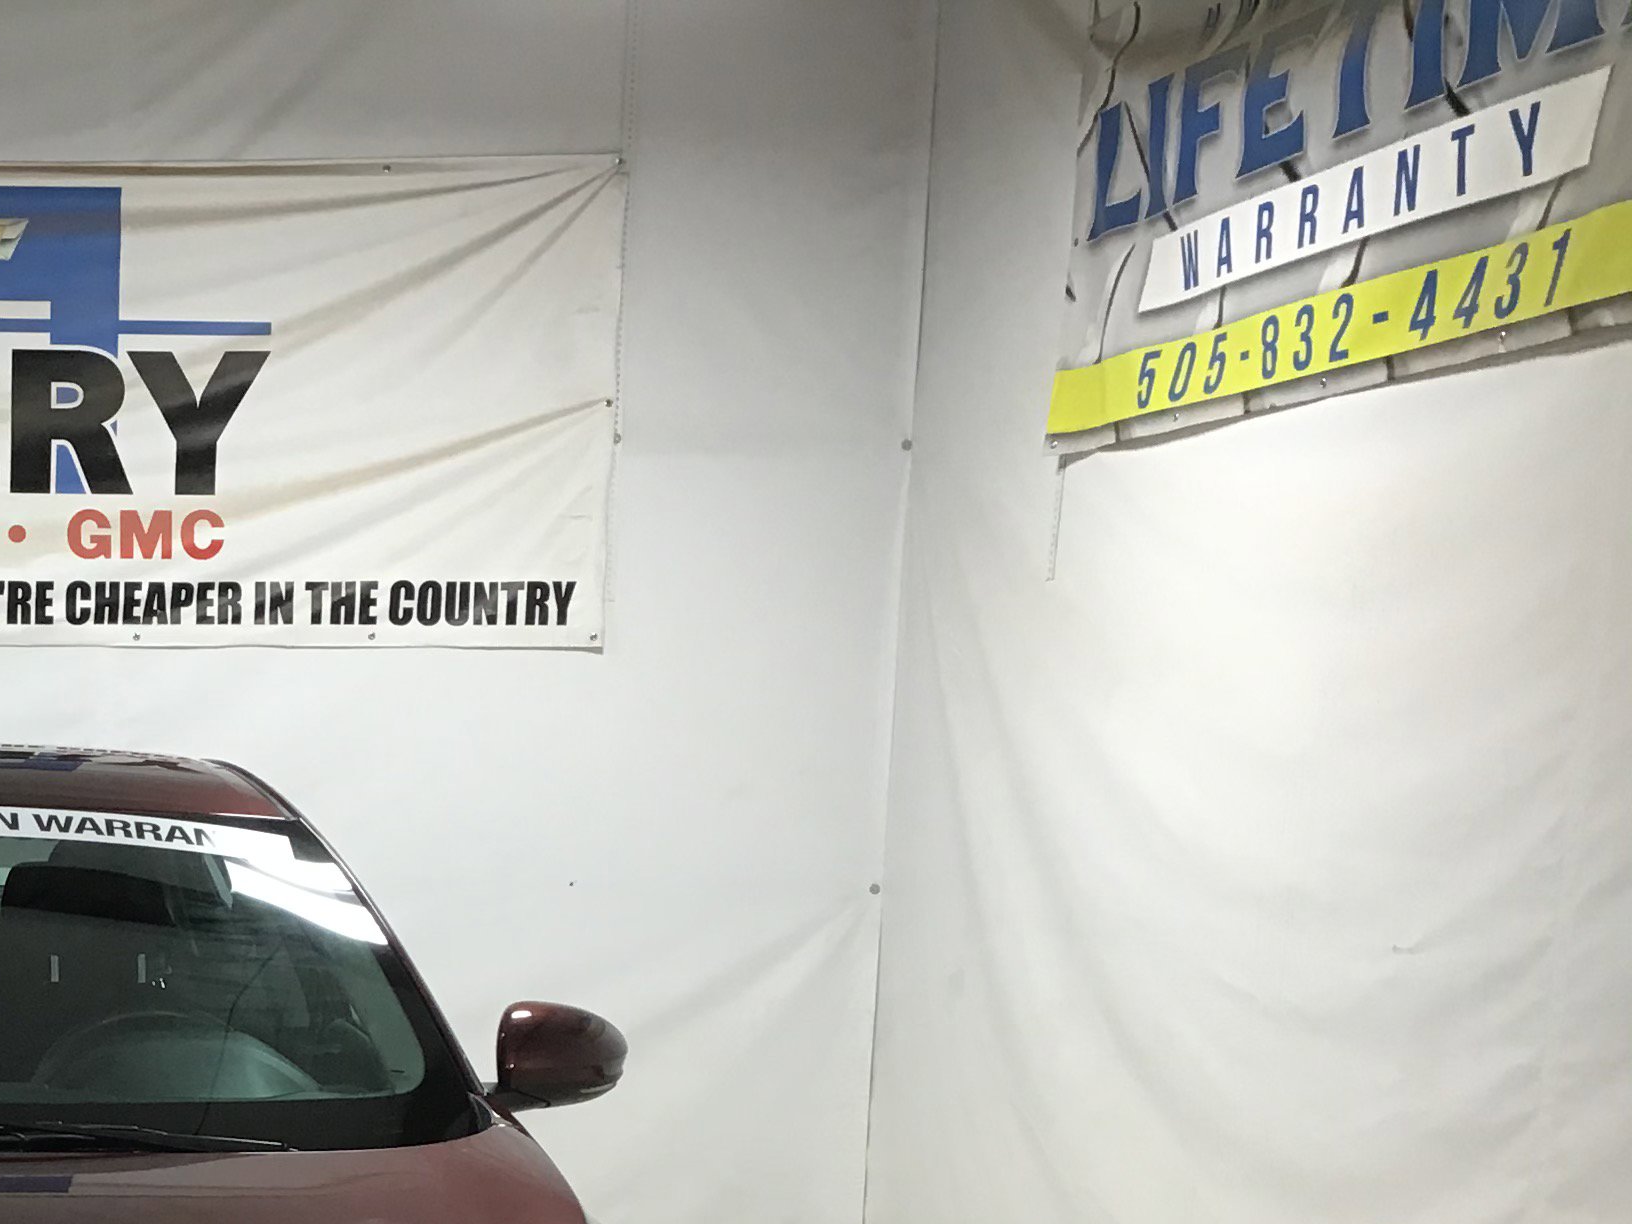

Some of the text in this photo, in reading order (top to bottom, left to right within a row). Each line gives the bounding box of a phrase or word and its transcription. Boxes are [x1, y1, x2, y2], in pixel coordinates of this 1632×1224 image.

[1087, 0, 1632, 242] LIFETIM
[1179, 102, 1541, 291] WARRANTY
[1136, 228, 1572, 409] 505-832-4431
[65, 580, 242, 626] CHEAPER
[254, 580, 296, 626] IN
[305, 580, 378, 626] THE
[388, 580, 577, 627] COUNTRY
[67, 508, 226, 560] GMC
